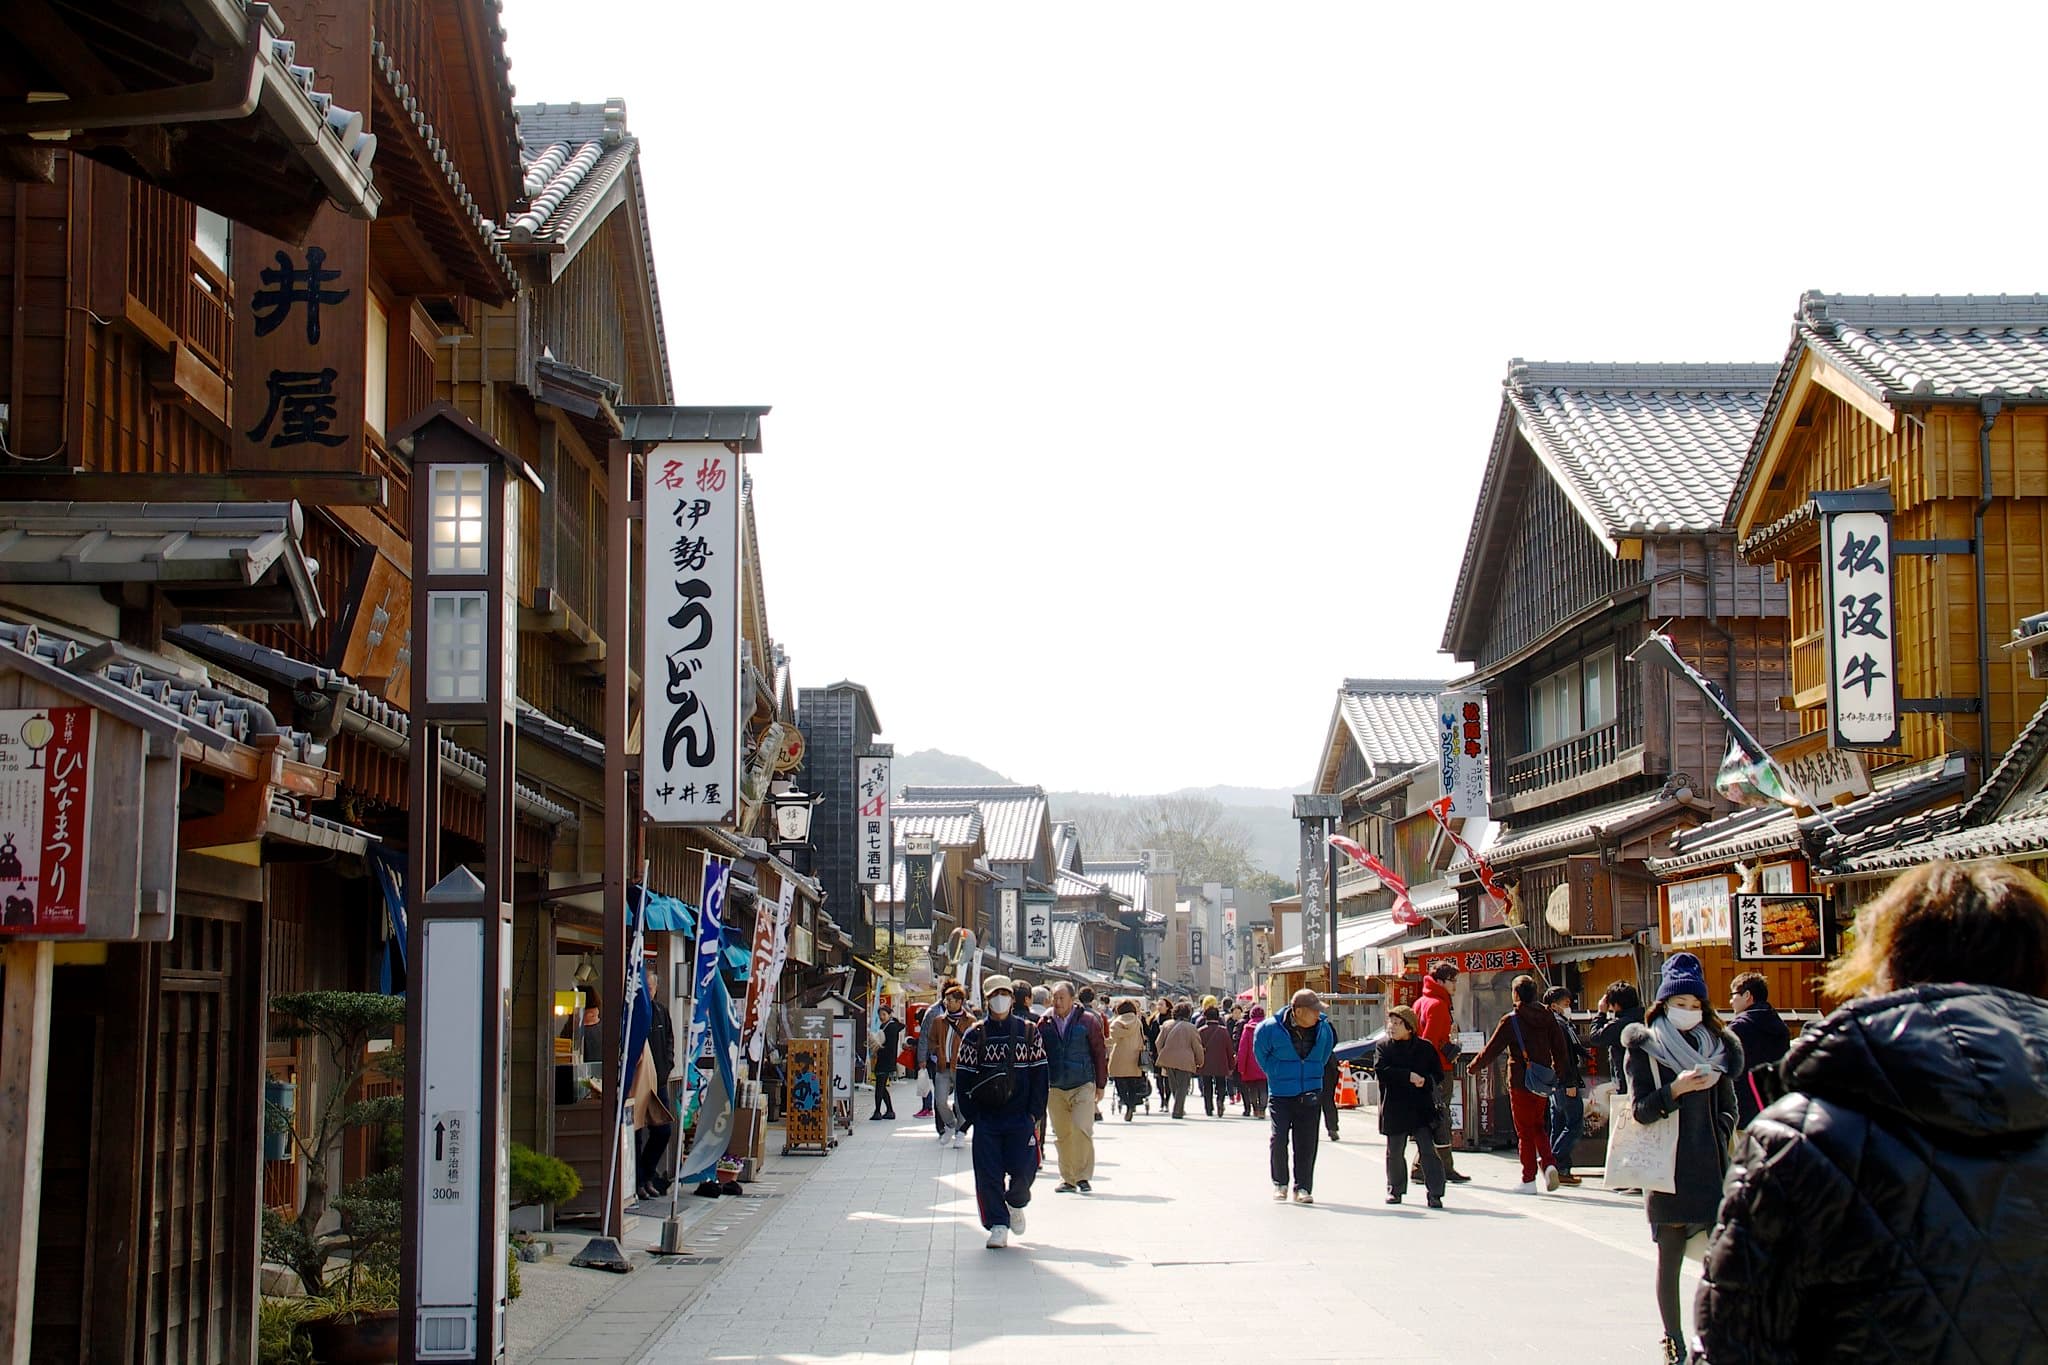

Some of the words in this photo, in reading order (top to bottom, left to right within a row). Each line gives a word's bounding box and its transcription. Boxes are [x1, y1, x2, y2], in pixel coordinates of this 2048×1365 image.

[246, 246, 350, 449] 井屋
[655, 458, 727, 493] 名物
[662, 498, 716, 773] 伊勢うどん
[1837, 530, 1888, 698] 松阪牛
[655, 782, 722, 805] 中井屋
[46, 747, 84, 903] ひなまつり
[866, 821, 881, 880] 岡七酒店
[1741, 896, 1758, 956] 松阪牛串
[448, 1119, 461, 1184] 内宮(宇治橋)
[432, 1188, 461, 1200] 300m
